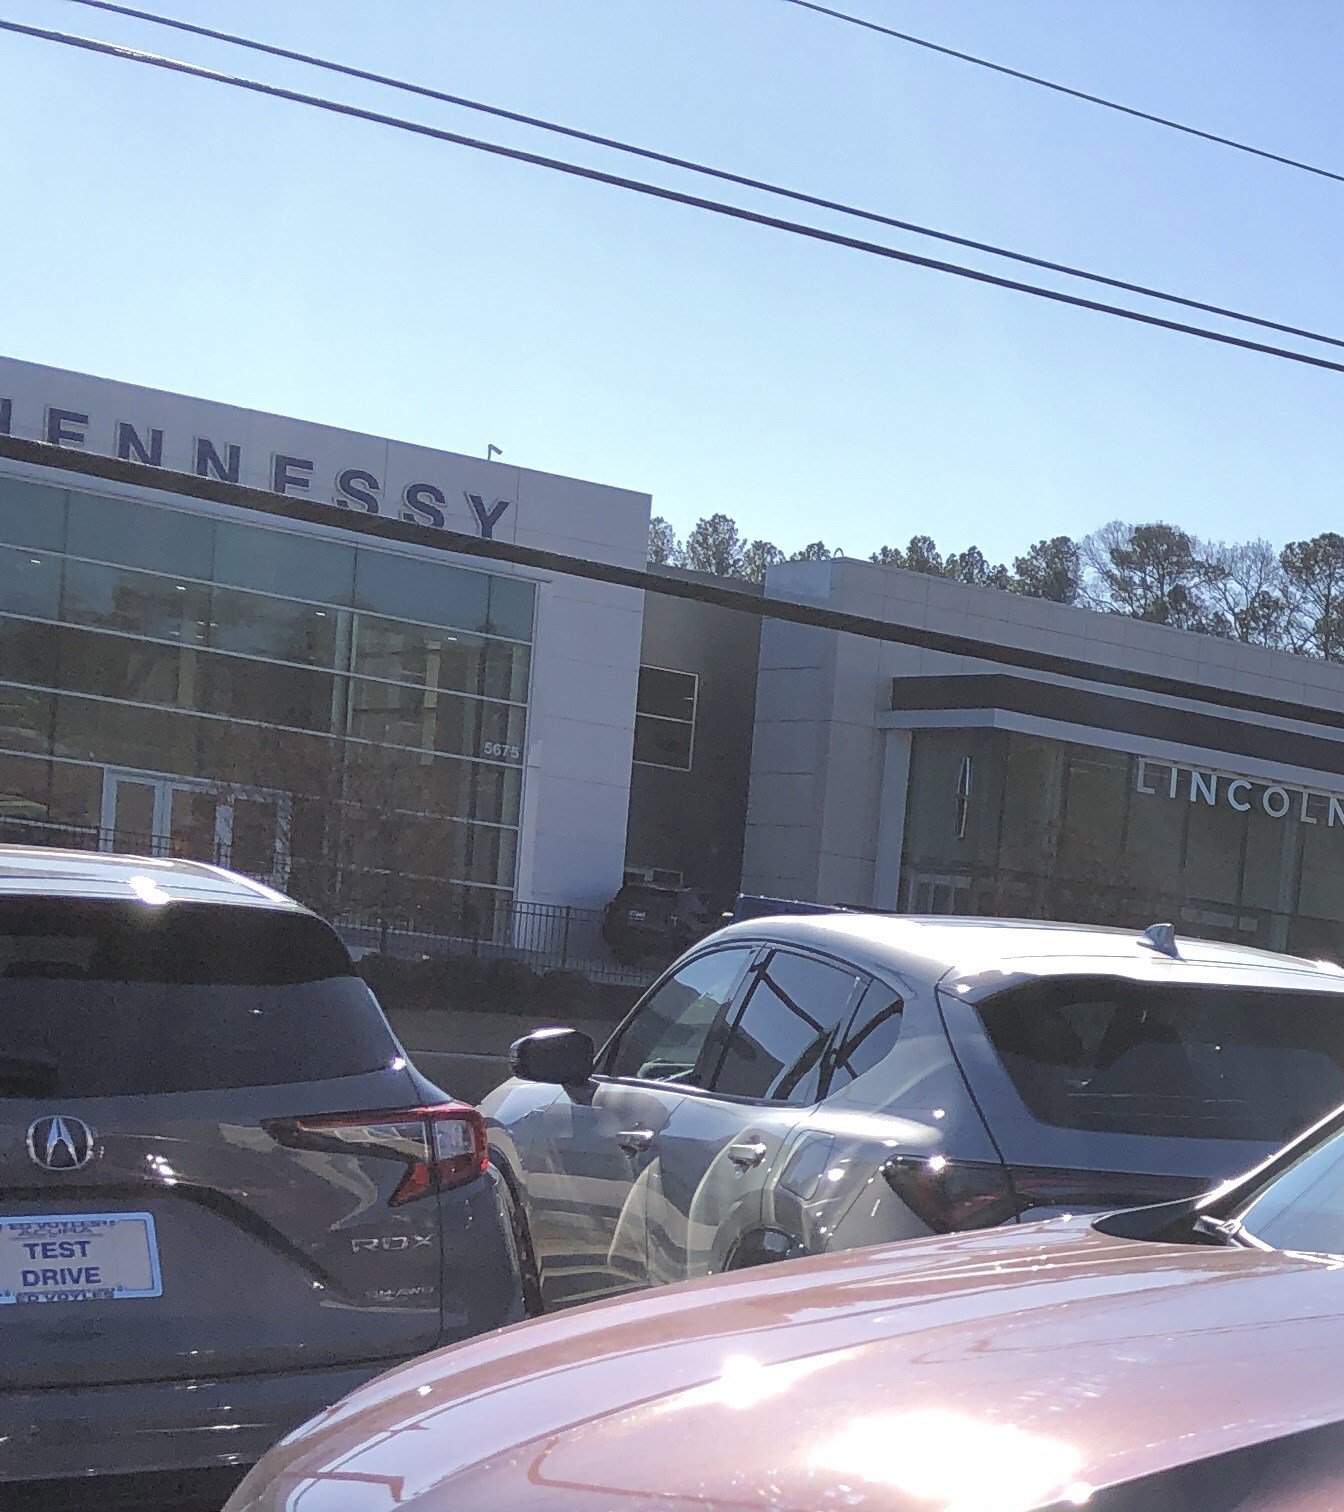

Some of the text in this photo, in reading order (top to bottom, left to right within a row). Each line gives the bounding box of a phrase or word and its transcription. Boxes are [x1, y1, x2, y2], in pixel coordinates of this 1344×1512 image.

[0, 397, 510, 541] ENNESSY
[484, 742, 520, 759] 5675
[22, 1240, 91, 1260] TEST
[352, 1233, 435, 1253] RDX
[21, 1266, 102, 1287] DRIVE
